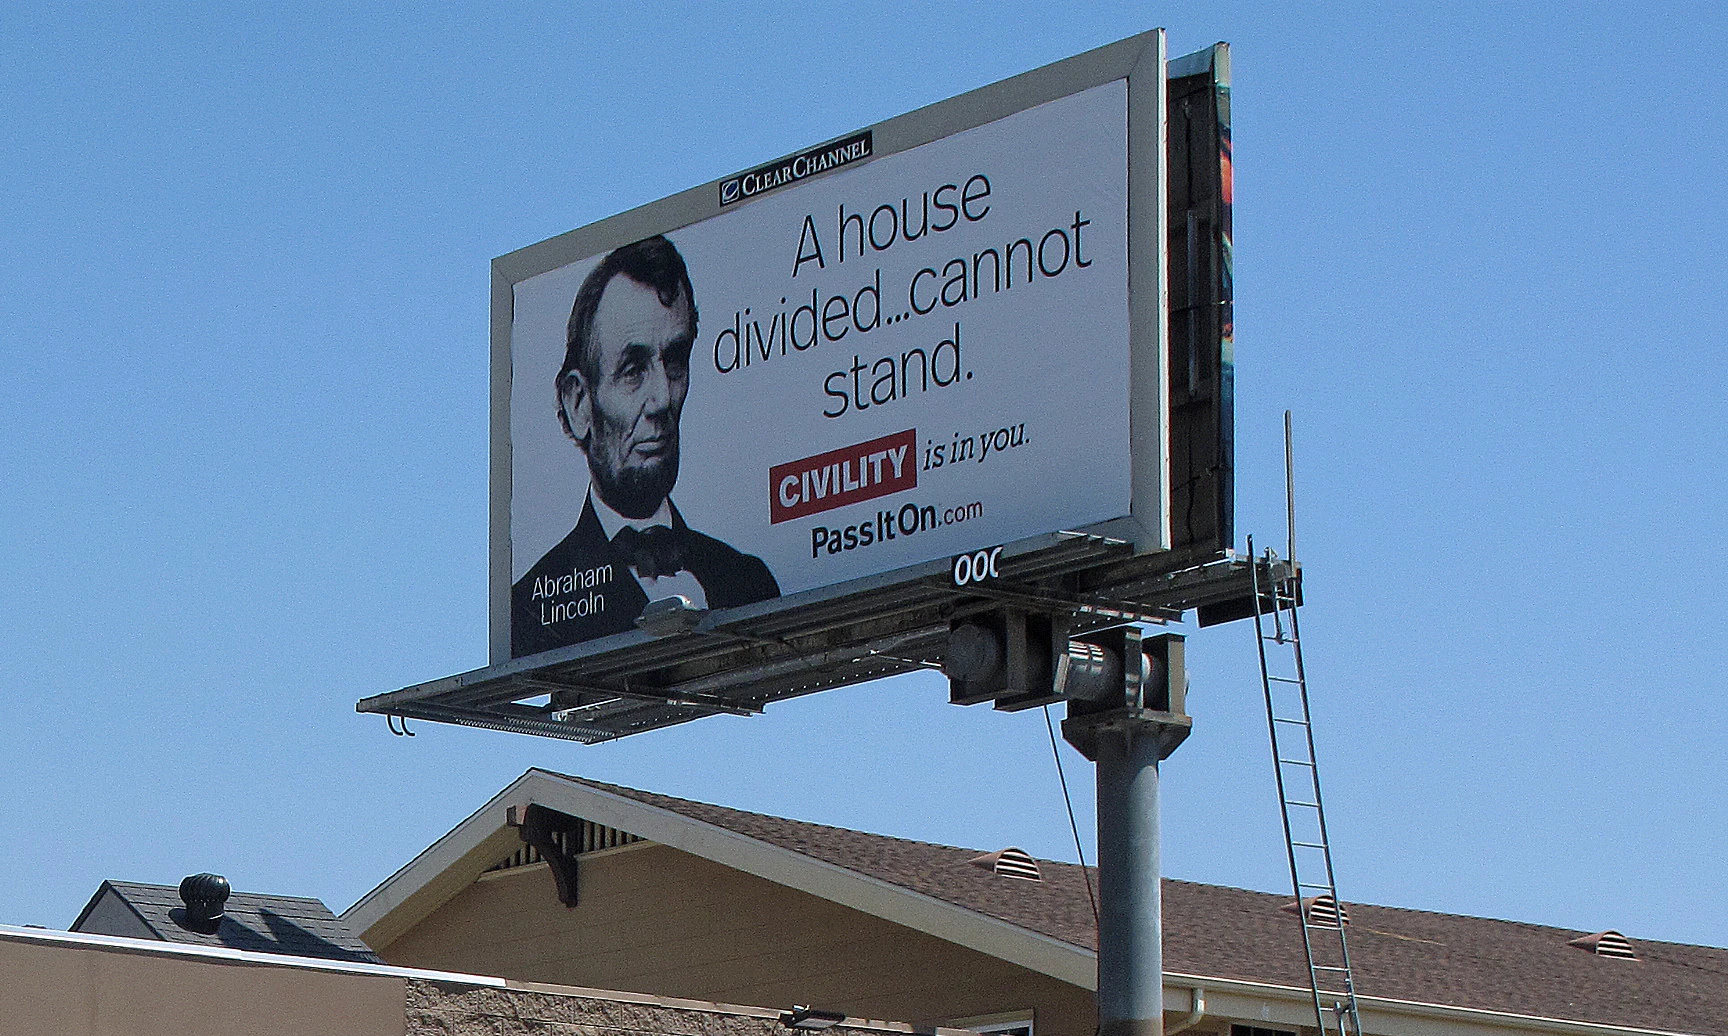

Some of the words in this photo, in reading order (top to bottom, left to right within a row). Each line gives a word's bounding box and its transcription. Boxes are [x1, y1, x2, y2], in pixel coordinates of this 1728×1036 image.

[792, 214, 825, 277] A
[839, 174, 991, 263] house
[823, 322, 973, 418] stand.
[779, 444, 909, 507] CIVILITY
[923, 440, 946, 471] is
[949, 432, 974, 464] in
[978, 423, 1031, 463] you.
[532, 564, 613, 600] Abraham
[541, 591, 604, 626] Lincoln
